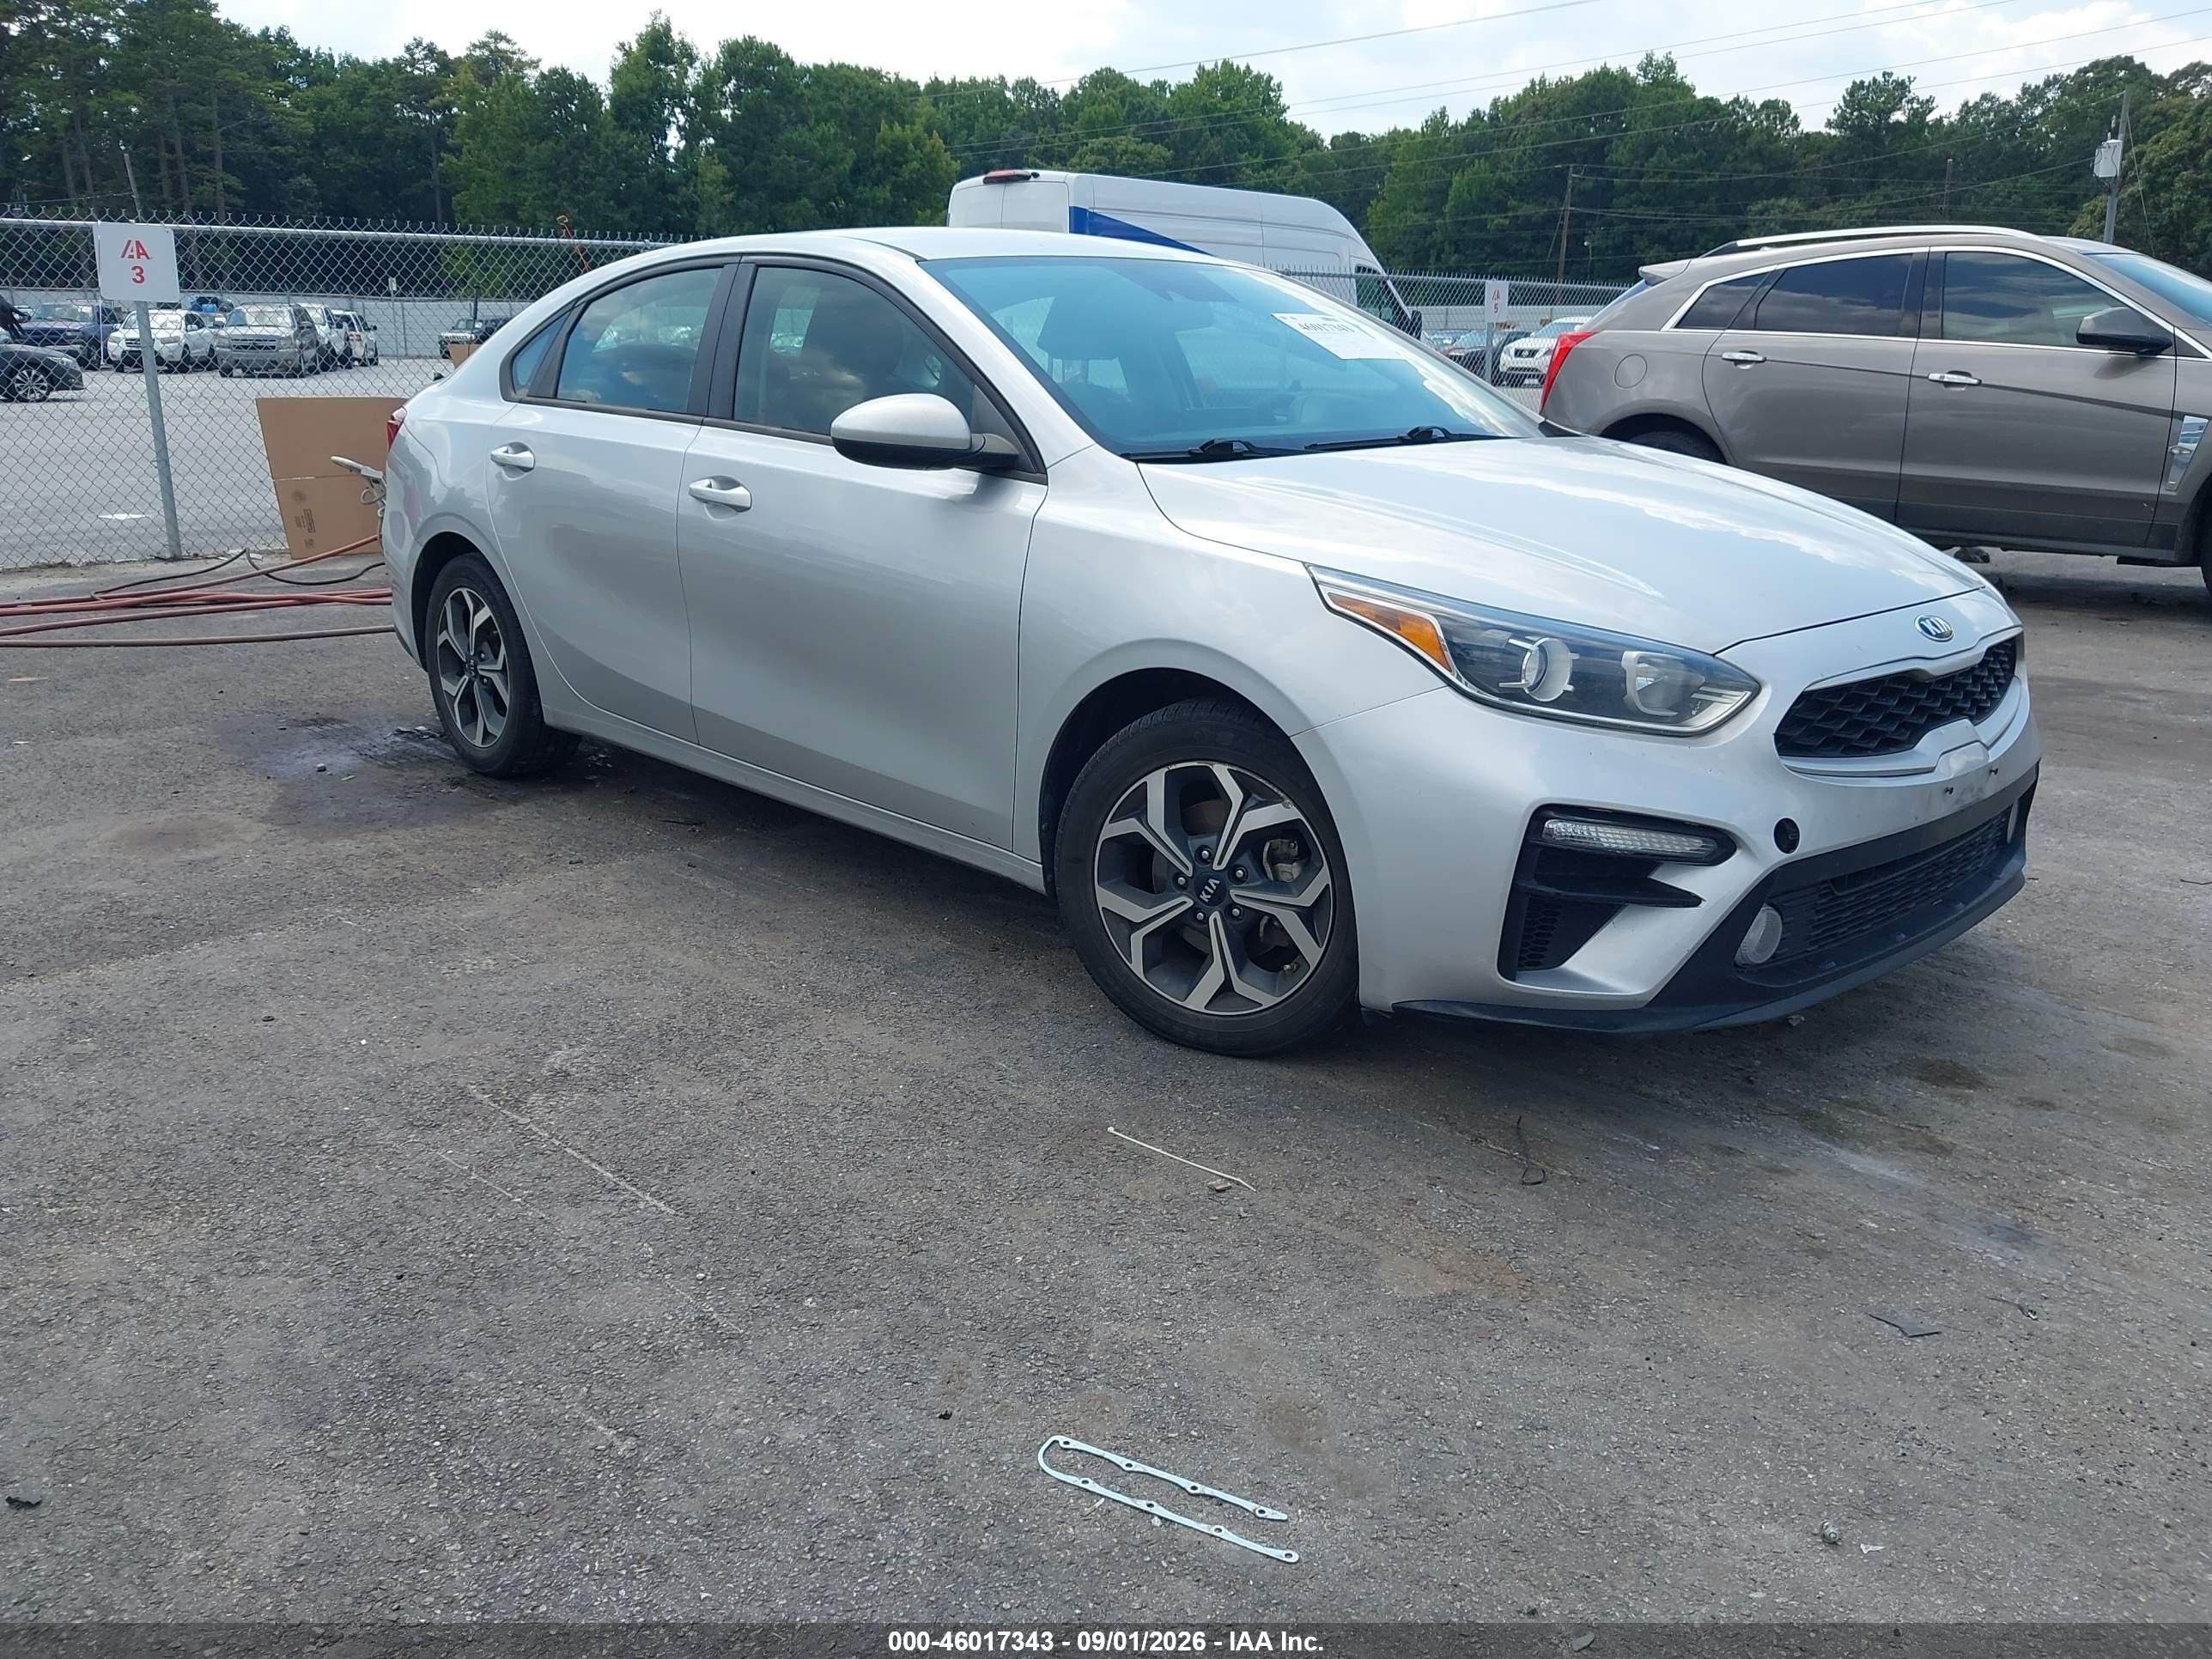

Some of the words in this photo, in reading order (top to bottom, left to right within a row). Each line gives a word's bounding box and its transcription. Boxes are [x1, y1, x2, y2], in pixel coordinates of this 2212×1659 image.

[131, 265, 145, 284] 3
[1493, 302, 1498, 314] 5
[1919, 617, 1952, 635] KIA
[1199, 878, 1221, 903] KIA
